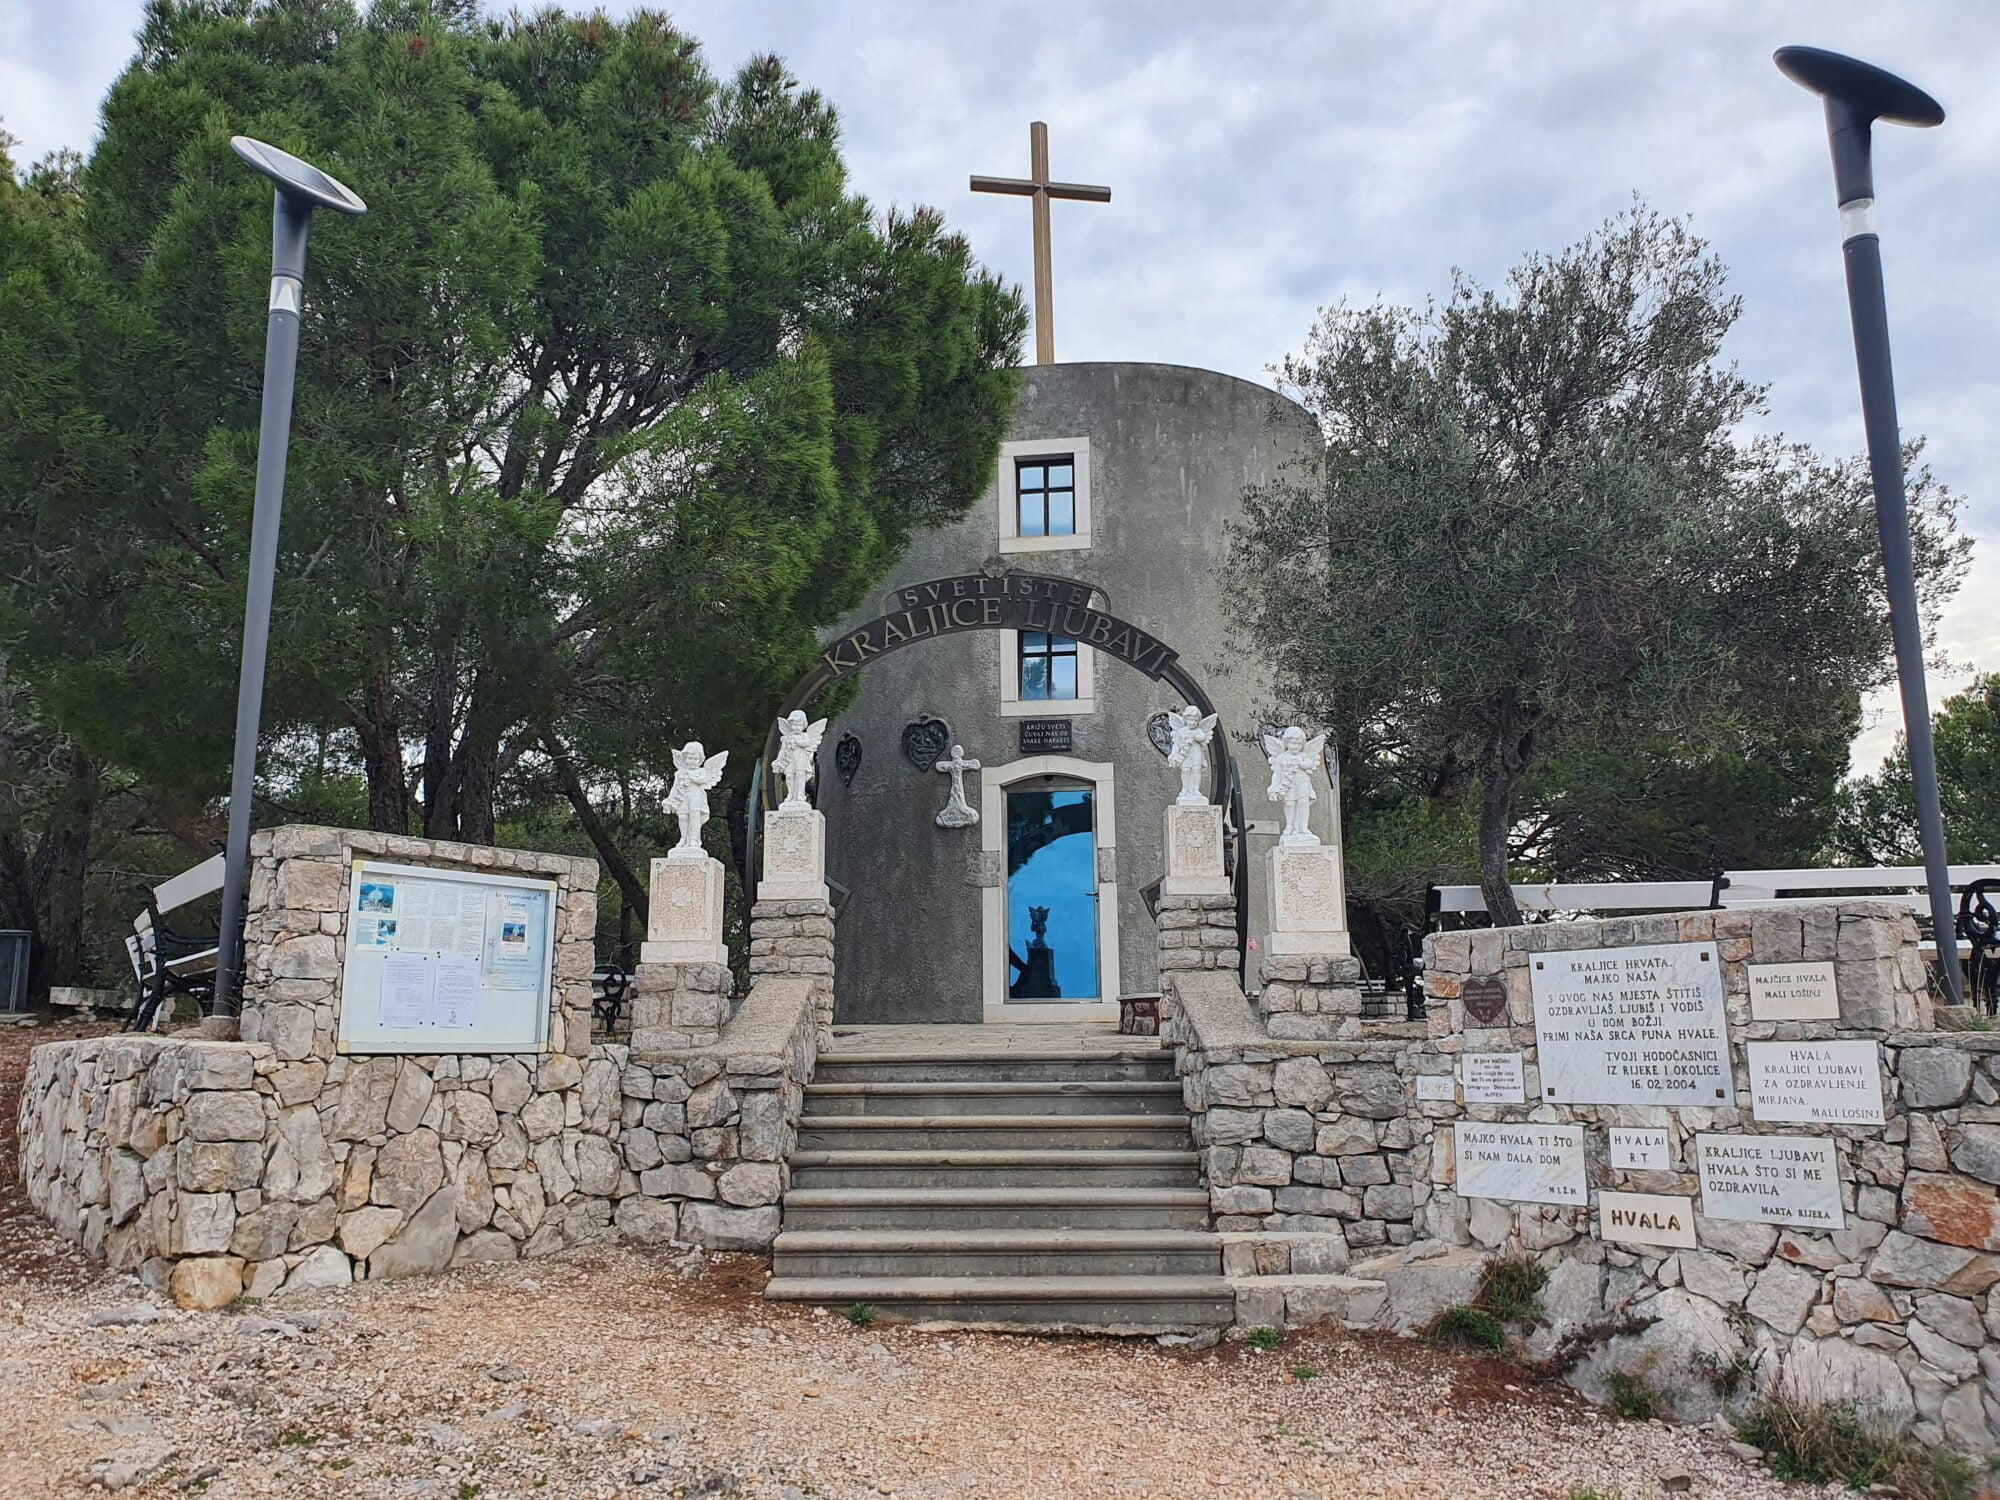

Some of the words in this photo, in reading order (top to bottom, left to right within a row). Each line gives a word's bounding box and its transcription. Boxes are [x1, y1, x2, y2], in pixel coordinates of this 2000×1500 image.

[904, 576, 1084, 607] SVETIŠTE
[822, 597, 1002, 678] KRALJICE
[1025, 599, 1172, 675] LJUBAVI
[1570, 960, 1618, 973] KRALJICE
[1584, 973, 1620, 985] MAJKO
[1626, 970, 1657, 983] NAŠA
[1755, 974, 1792, 985] MAJČICE
[1796, 974, 1827, 983] HVALA
[1548, 993, 1554, 1004] S
[1558, 992, 1587, 1004] OVOG
[1592, 991, 1614, 1002] NAS
[1620, 989, 1660, 1001] MJESTA
[1764, 990, 1787, 999] MALI
[1791, 988, 1821, 998] LOŠINJ
[1620, 1001, 1655, 1014] LJUBIŠ
[1661, 1003, 1665, 1013] I
[1671, 1000, 1704, 1013] VODIŠ
[1588, 1018, 1596, 1028] U
[1602, 1017, 1625, 1028] DOM
[1543, 1031, 1570, 1042] PRIMI
[1575, 1029, 1604, 1041] NAŠA
[1608, 1030, 1636, 1041] SRCA
[1641, 1029, 1672, 1041] PUNA
[1606, 1051, 1638, 1062] TVOJI
[1643, 1049, 1718, 1062] HODOČASNICI
[1790, 1050, 1832, 1061] HVALA
[1607, 1065, 1618, 1076] IZ
[1623, 1065, 1659, 1076] RIJEKE
[1664, 1065, 1668, 1076] I
[1673, 1065, 1721, 1076] OKOLICE
[1764, 1064, 1810, 1075] KRALJICI
[1818, 1065, 1863, 1075] LJUBAVI
[1763, 1079, 1778, 1089] ZA
[1785, 1079, 1868, 1090] OZDRAVLJENJE
[1811, 1108, 1838, 1118] MALI
[1842, 1107, 1880, 1119] LOŠINJ
[1463, 1132, 1496, 1144] MAJKO
[1500, 1134, 1533, 1146] HVALA
[1538, 1136, 1549, 1146] TI
[1553, 1135, 1573, 1148] ŠTO
[1464, 1150, 1473, 1160] SI
[1478, 1151, 1500, 1162] NAM
[1507, 1153, 1533, 1164] DALA
[1539, 1154, 1561, 1166] DOM
[1705, 1146, 1763, 1160] KRALJICE
[1770, 1149, 1825, 1163] LJUBAVI
[1706, 1163, 1749, 1177] HVALA
[1755, 1164, 1779, 1179] ŠTO
[1785, 1167, 1797, 1180] SI
[1803, 1168, 1822, 1181] ME
[1709, 1180, 1780, 1196] OZDRAVILA
[1761, 1205, 1793, 1217] MARTA
[1798, 1208, 1832, 1220] RIJEKA
[1611, 1209, 1682, 1231] HVALA
